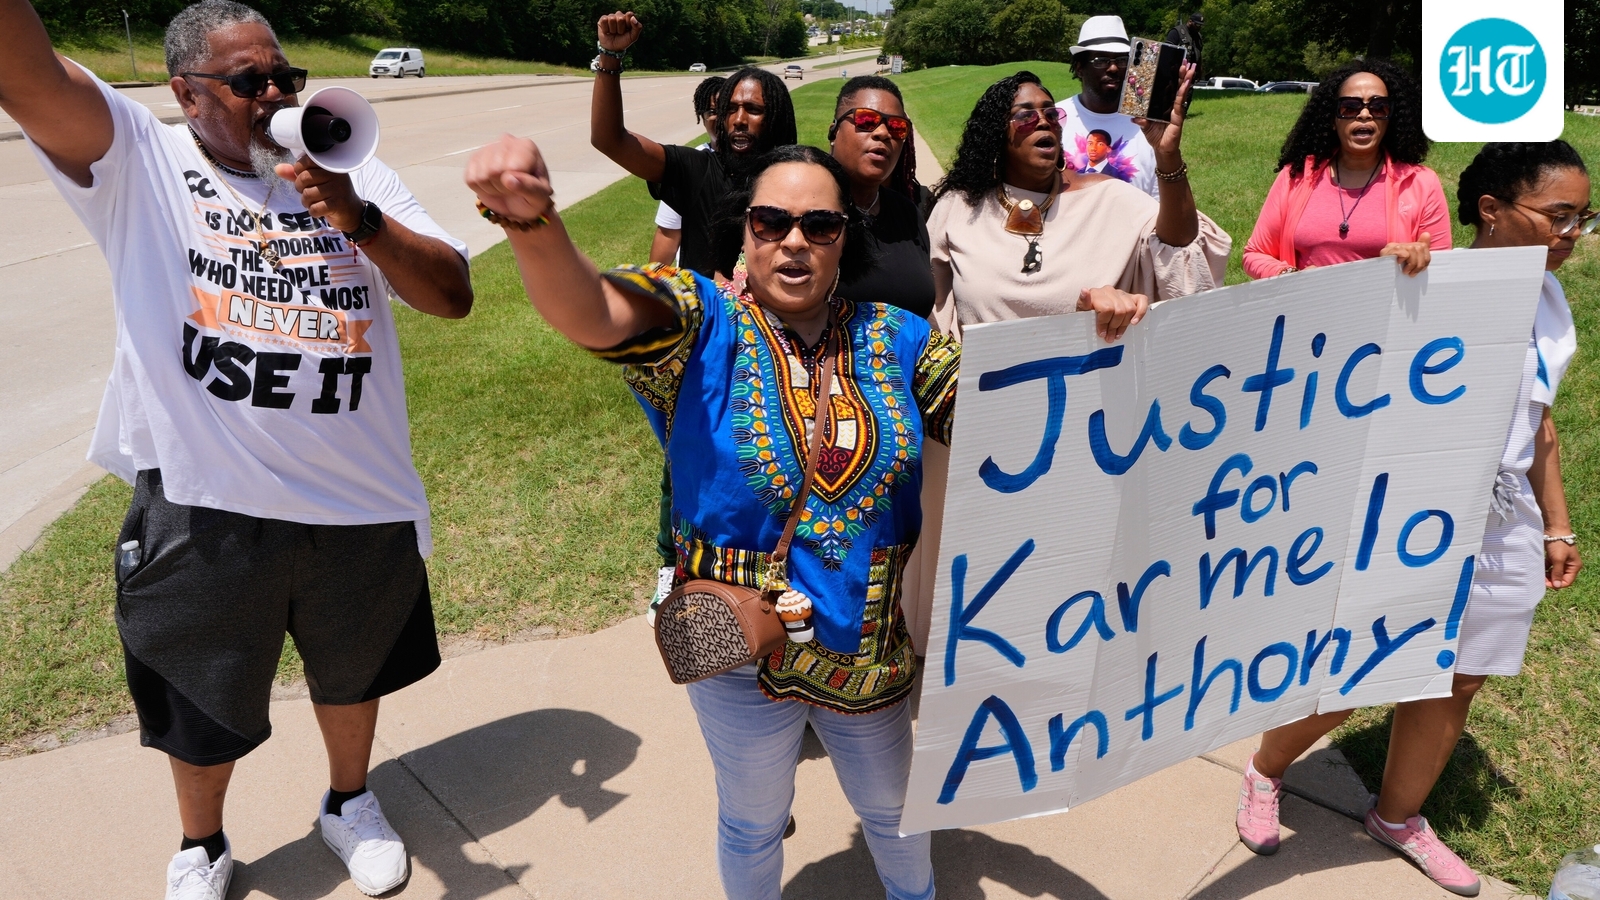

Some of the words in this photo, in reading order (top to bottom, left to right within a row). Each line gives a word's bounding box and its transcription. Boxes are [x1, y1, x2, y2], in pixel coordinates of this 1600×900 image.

[205, 211, 221, 231] IS
[228, 247, 264, 273] THE
[188, 248, 237, 290] WHO
[240, 273, 293, 303] NEED
[319, 286, 371, 311] MOST
[228, 295, 340, 340] NEVER
[182, 321, 302, 410] USE
[311, 356, 373, 415] IT
[978, 315, 1468, 494] Justice
[1191, 452, 1319, 540] for
[943, 472, 1455, 687] Karmelo
[936, 555, 1475, 805] Anthony!
